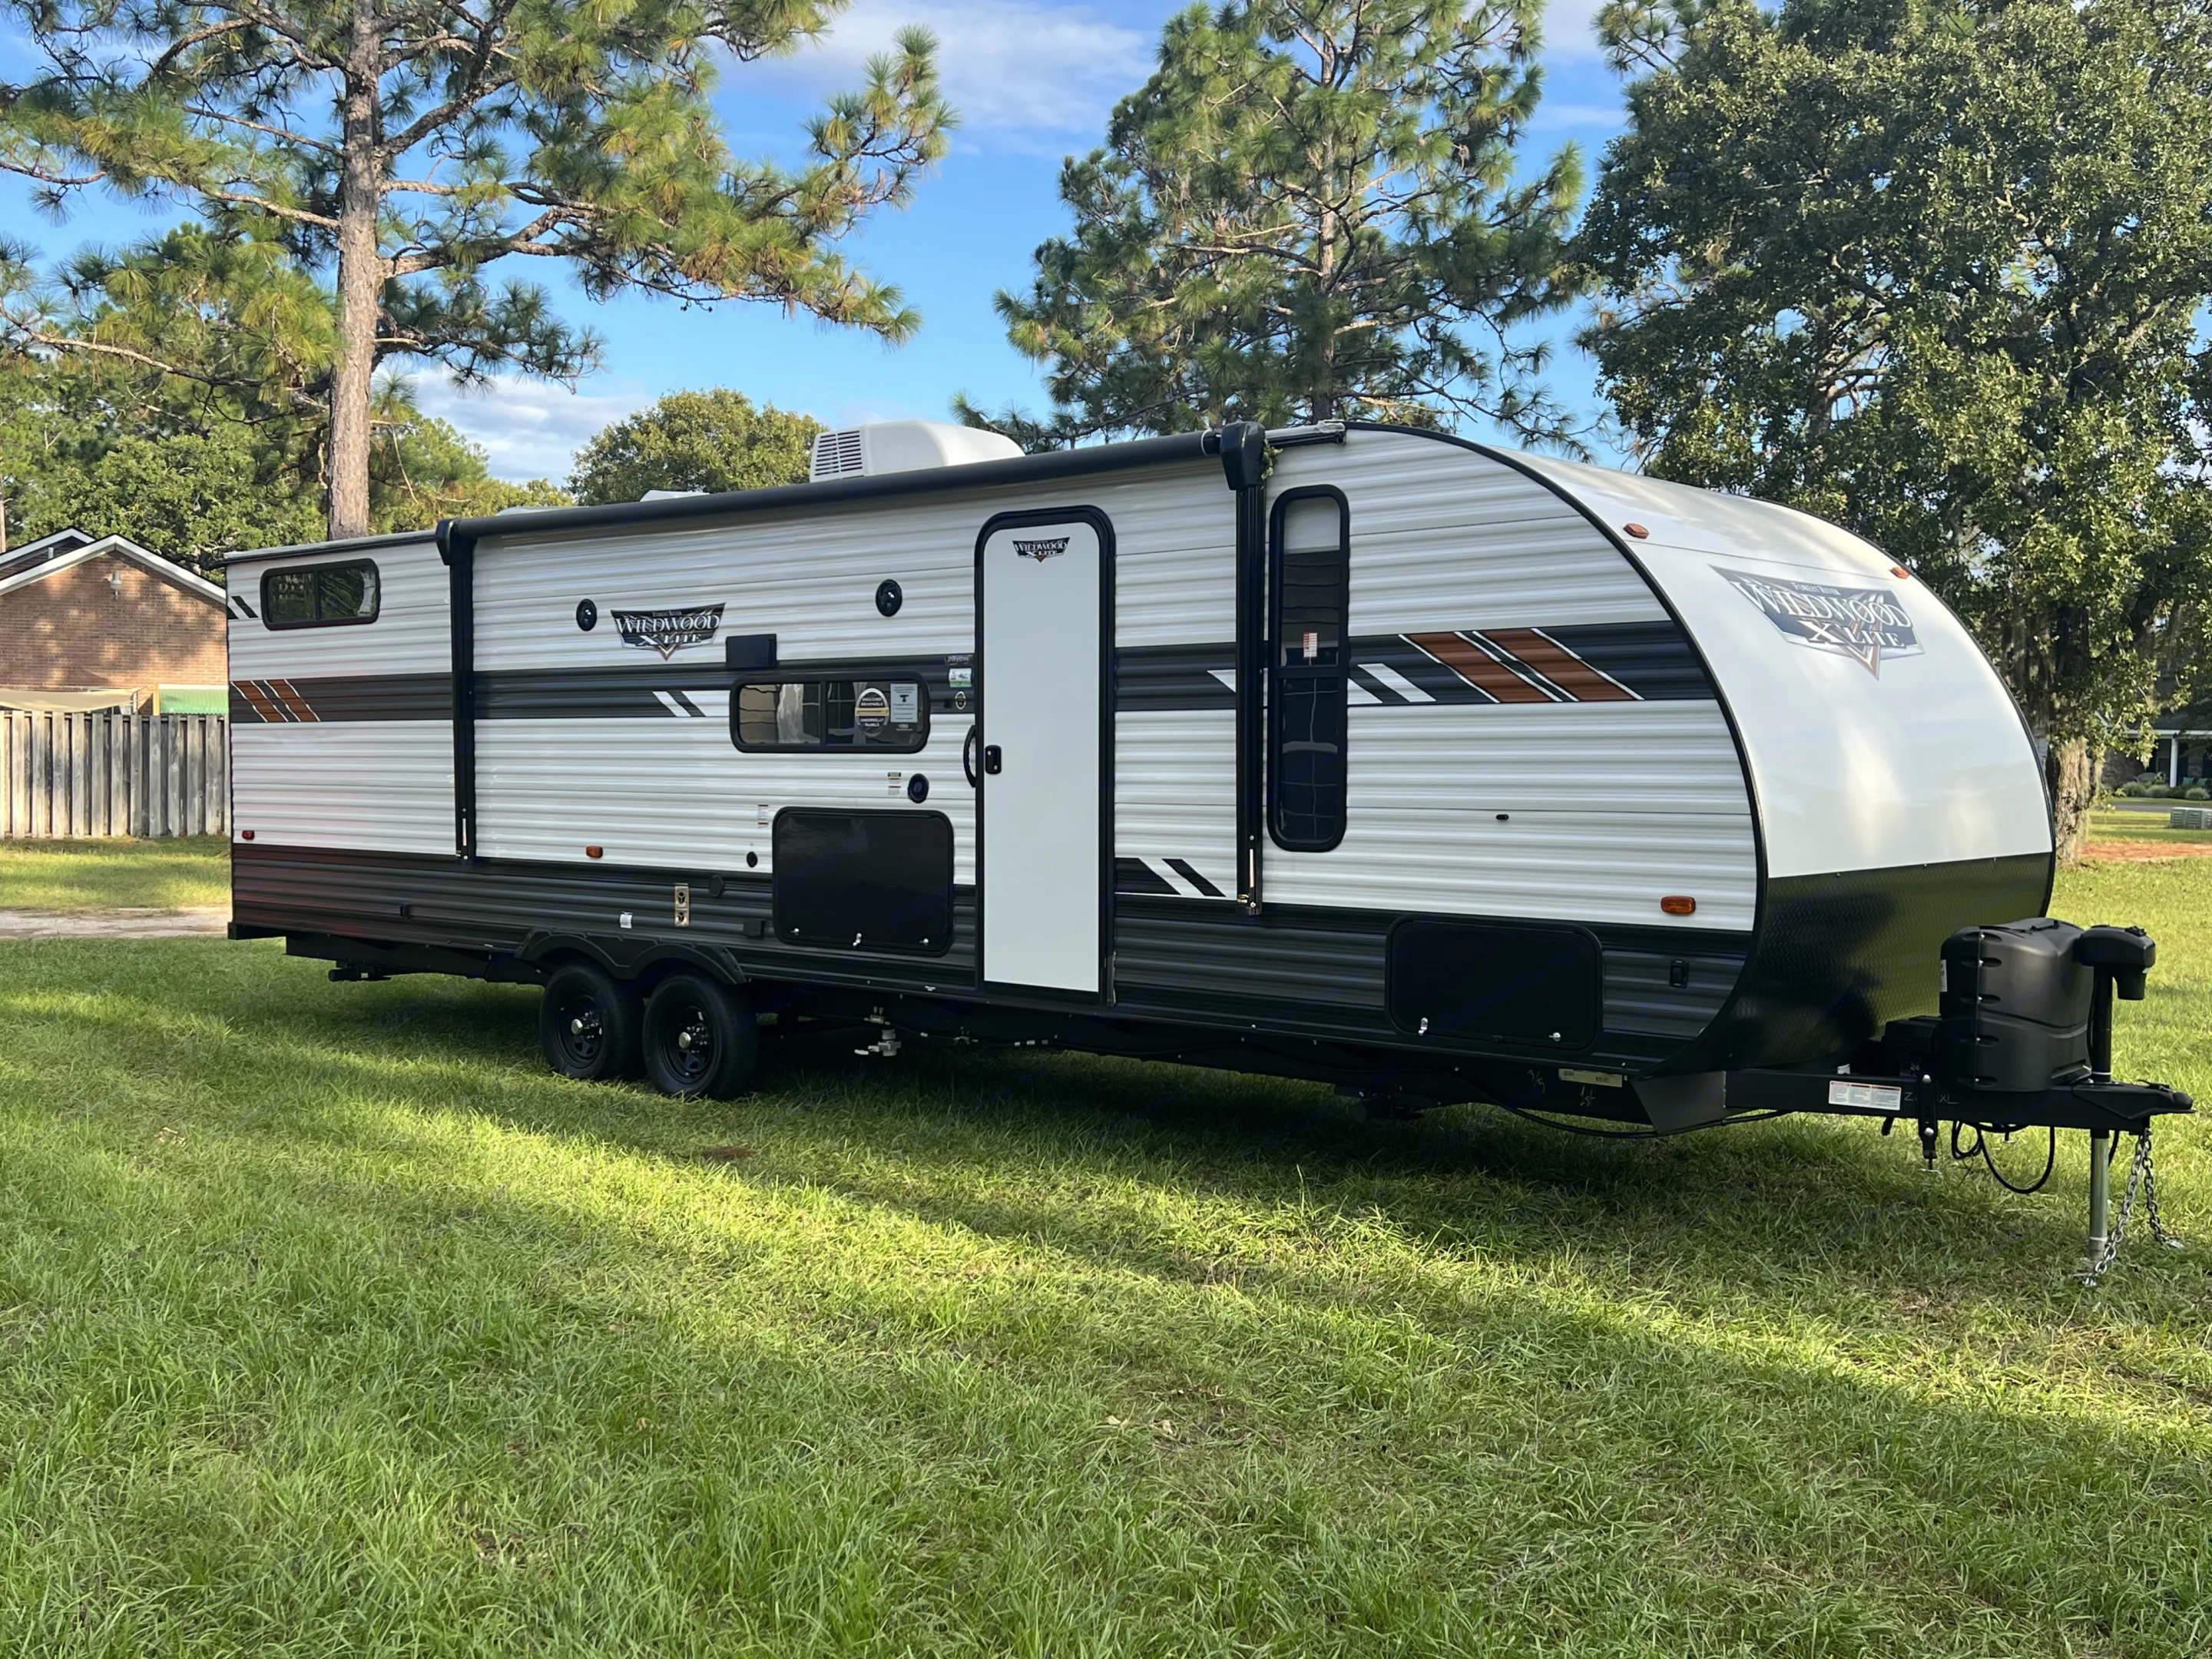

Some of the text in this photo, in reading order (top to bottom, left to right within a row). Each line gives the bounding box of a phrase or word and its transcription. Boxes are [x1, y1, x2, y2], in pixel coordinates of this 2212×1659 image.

[1014, 541, 1067, 551] WILDWOOD
[1730, 581, 1913, 628] WILDWOOD
[616, 615, 720, 634] WILDWOOD
[1797, 619, 1906, 647] X LITE
[637, 633, 702, 647] X LITE
